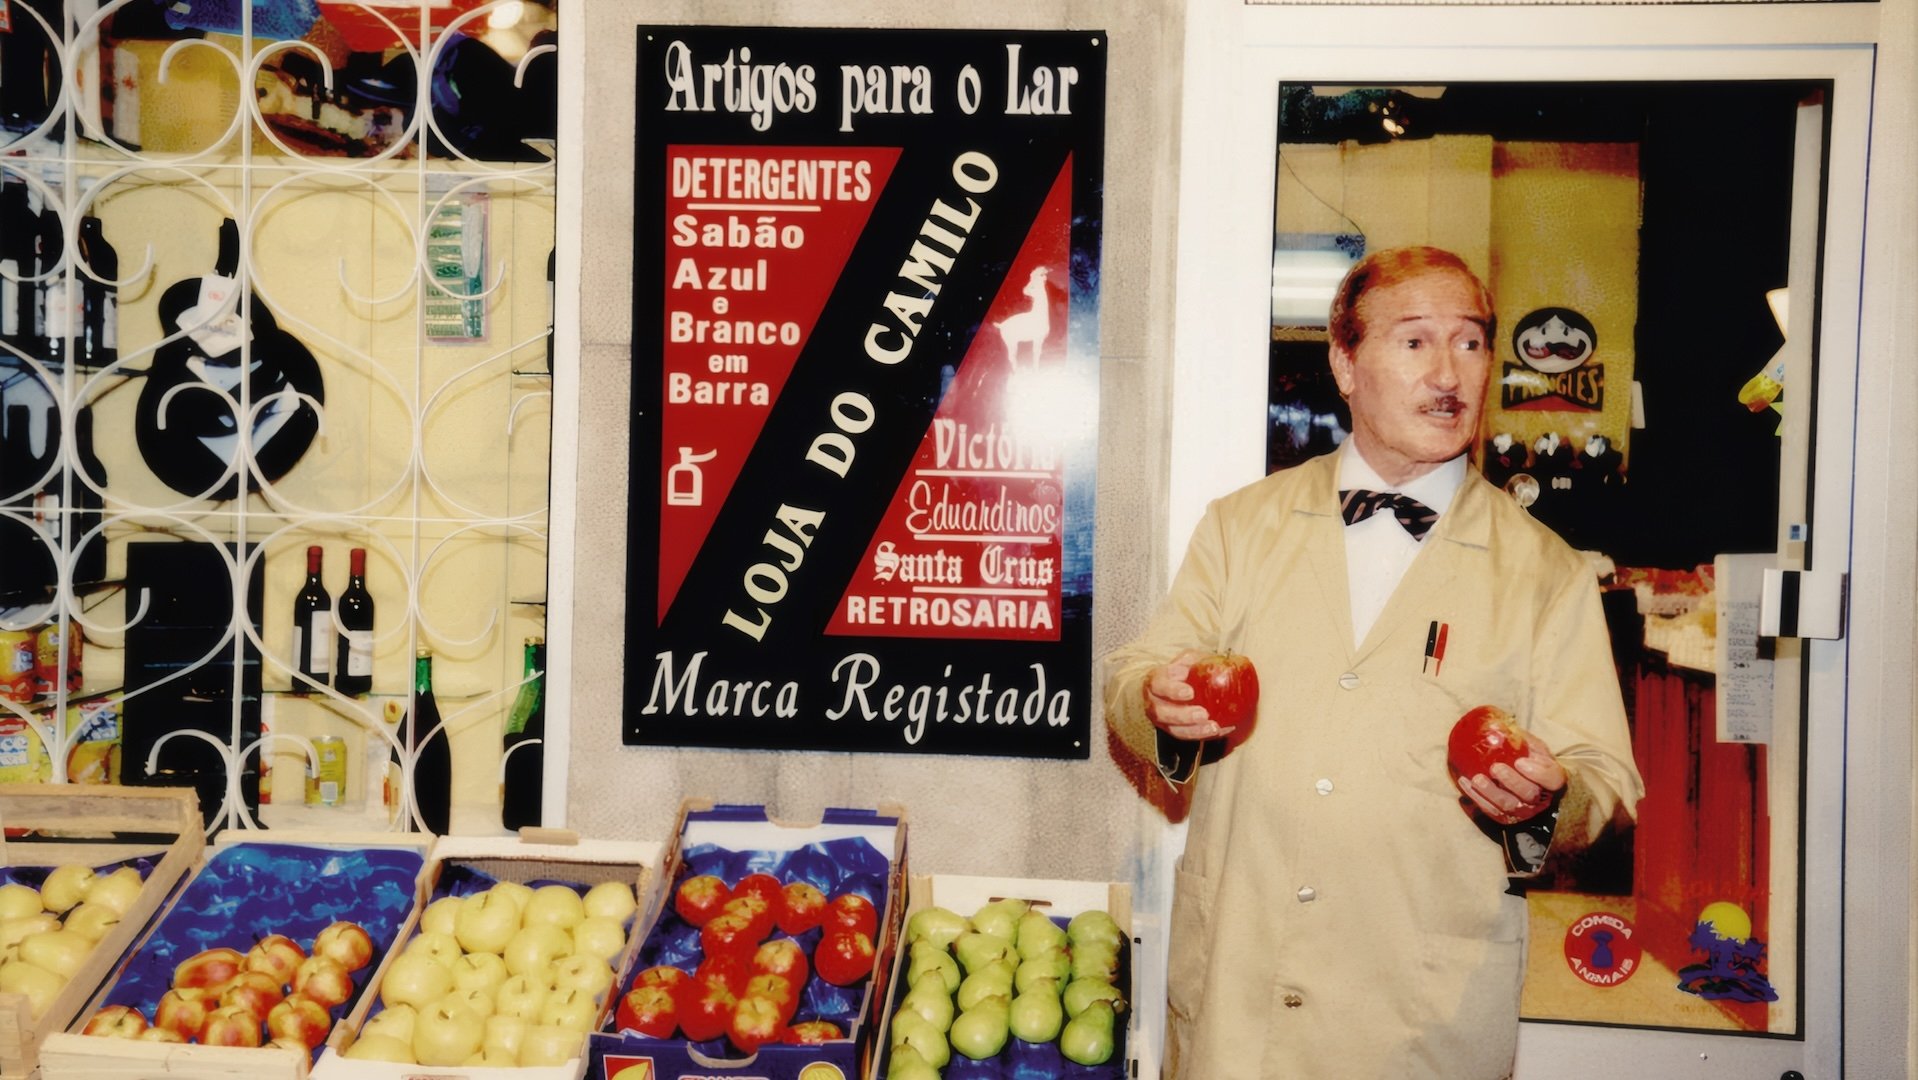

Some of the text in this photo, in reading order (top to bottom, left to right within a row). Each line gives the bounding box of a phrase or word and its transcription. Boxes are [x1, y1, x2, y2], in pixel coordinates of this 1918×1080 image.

[664, 40, 1079, 132] Artigos para o Lar
[672, 157, 872, 202] DETERGENTES
[672, 214, 805, 249] Sabão
[672, 258, 767, 291] Azul
[712, 296, 729, 315] e
[670, 311, 801, 346] Branco
[708, 354, 749, 374] em
[668, 372, 769, 406] Barra
[722, 150, 1000, 643] LOJA DO CAMILO
[905, 480, 1057, 535] Eduardinos
[873, 540, 964, 585] Santa
[847, 595, 1053, 630] RETROSARIA
[641, 650, 1071, 745] Marca Registada
